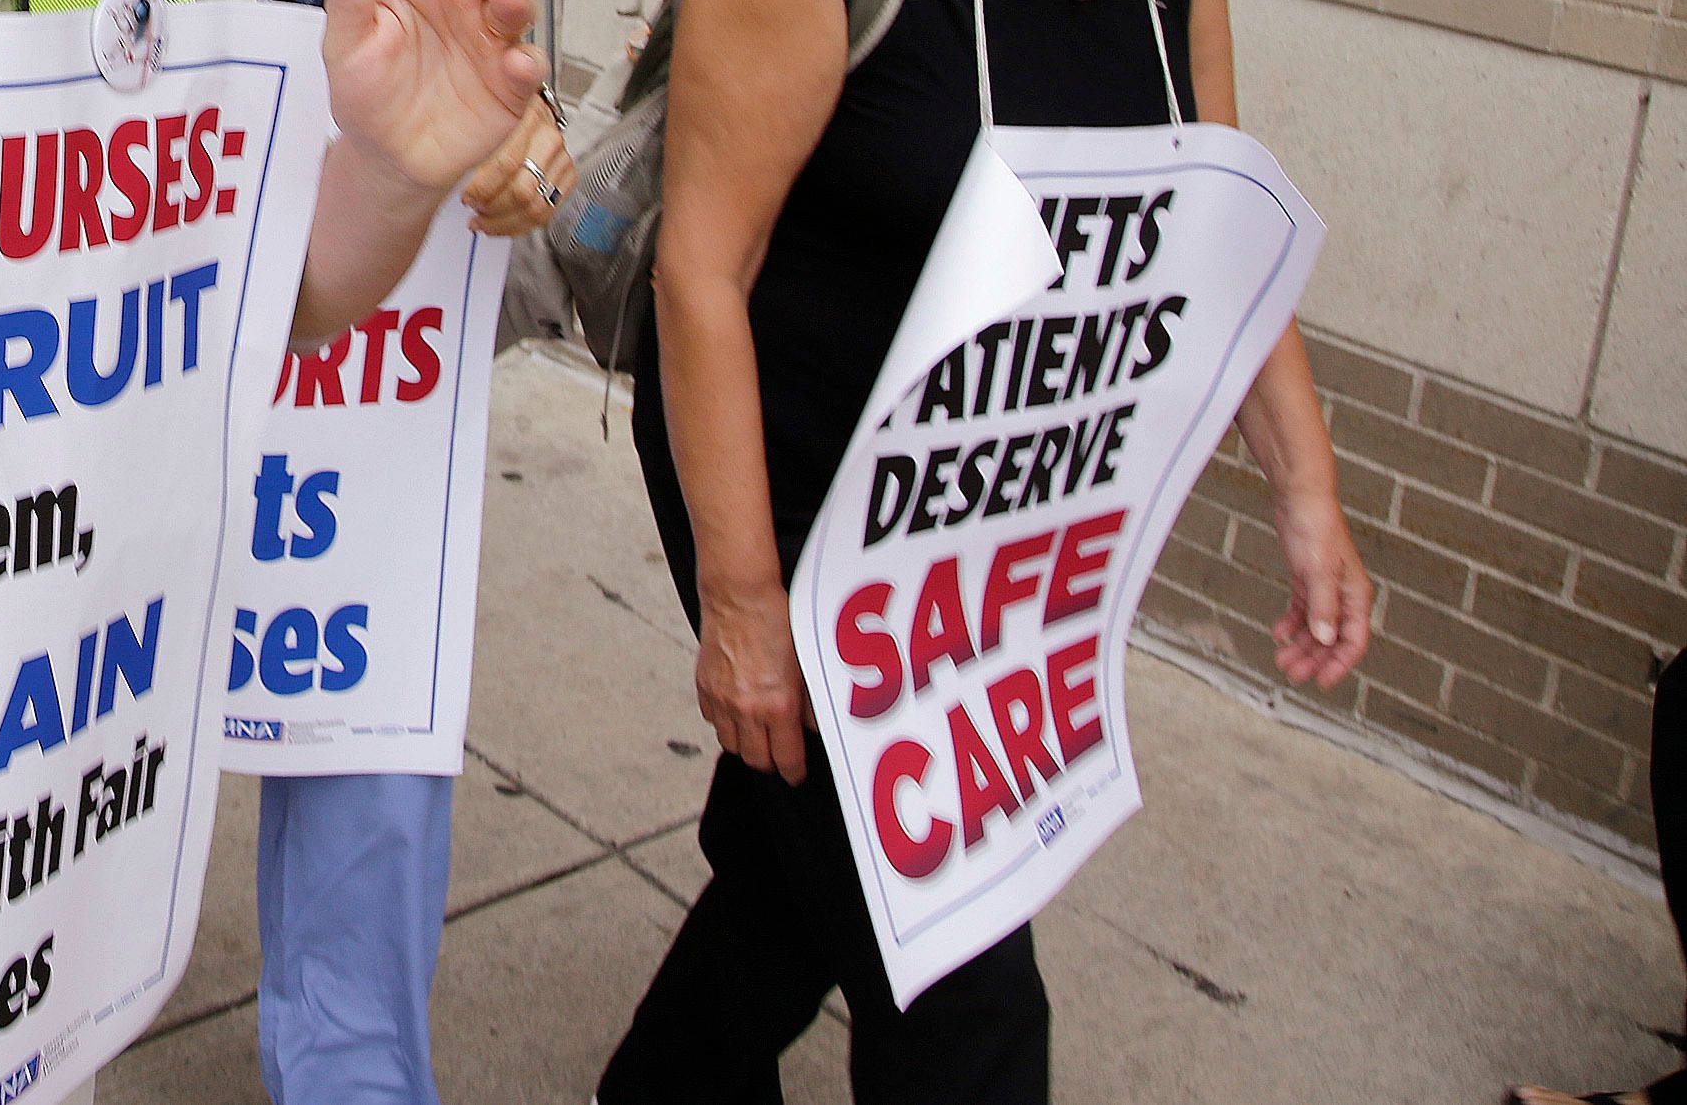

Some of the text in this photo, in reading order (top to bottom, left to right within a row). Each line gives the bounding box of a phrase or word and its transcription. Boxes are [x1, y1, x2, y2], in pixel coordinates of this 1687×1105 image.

[877, 295, 1189, 430] ATIENTS
[251, 453, 341, 562] ts
[862, 402, 1136, 549] DESERVE
[835, 509, 1127, 719] SAFE
[73, 735, 167, 859] Fair
[872, 635, 1104, 878] CARE
